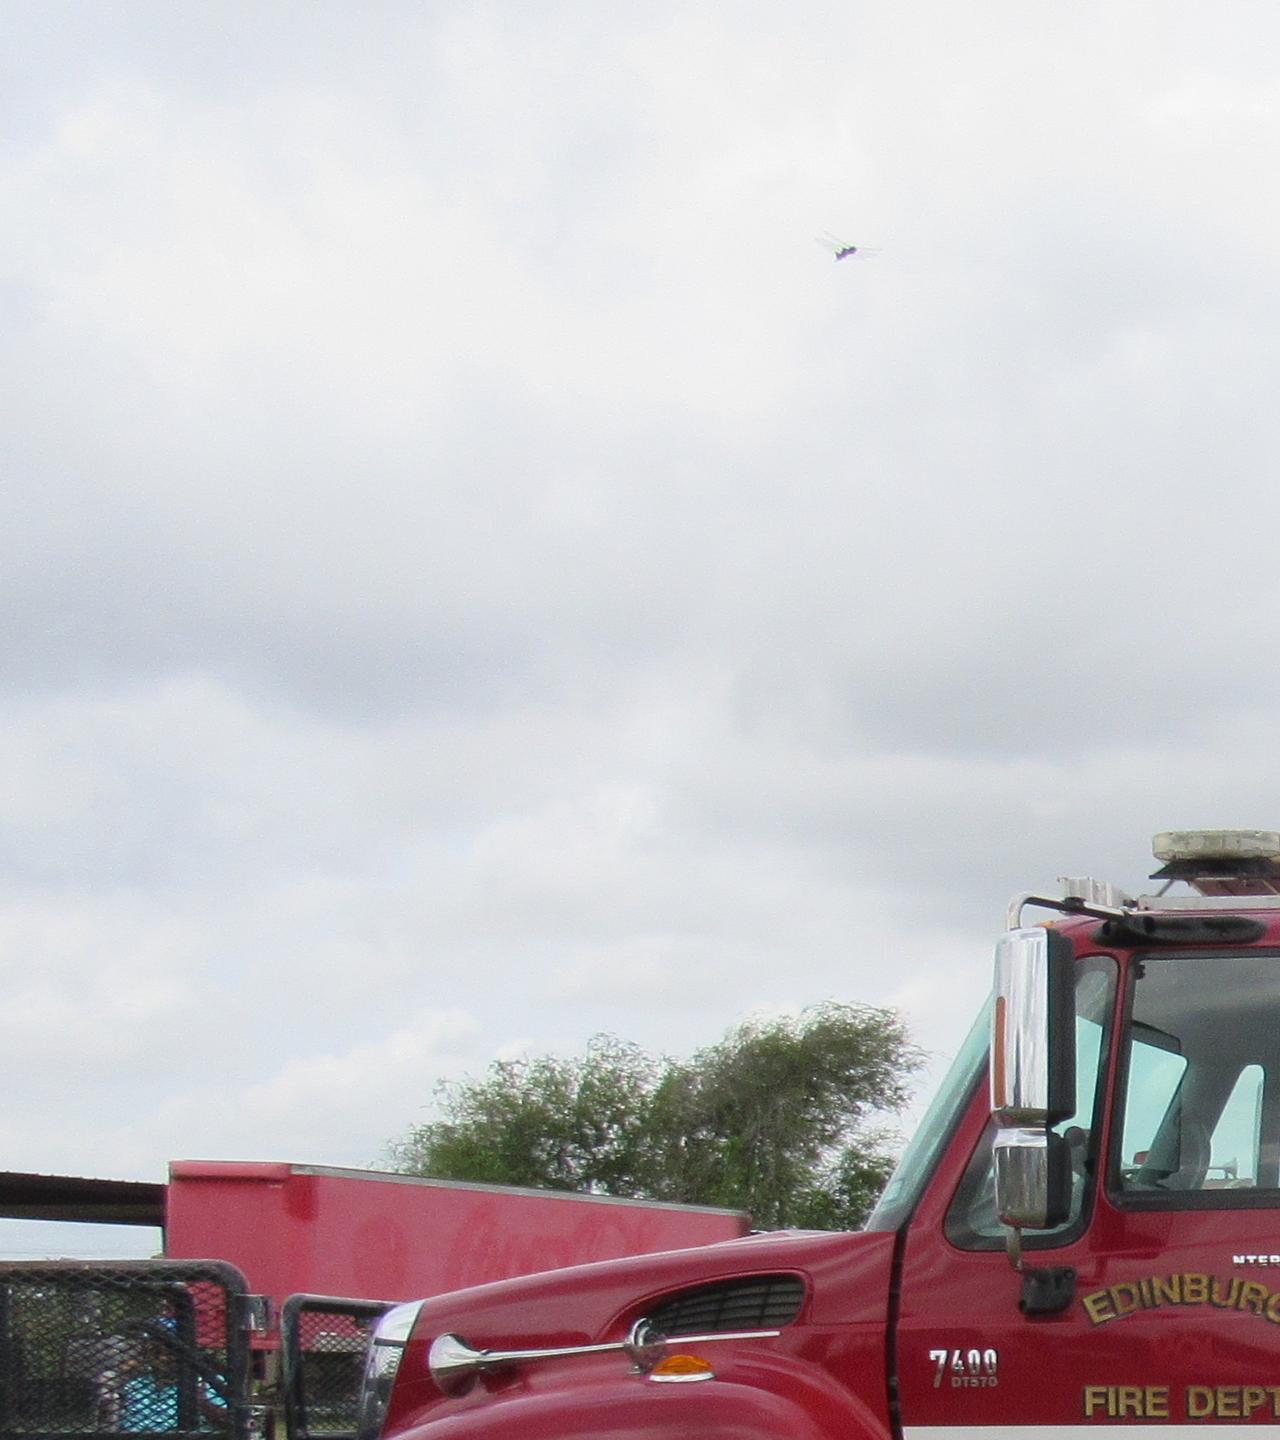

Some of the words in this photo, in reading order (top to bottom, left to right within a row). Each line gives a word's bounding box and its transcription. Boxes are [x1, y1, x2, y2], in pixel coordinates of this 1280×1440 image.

[928, 1348, 999, 1389] 7400
[951, 1376, 999, 1388] DT570
[1083, 1386, 1171, 1419] FIRE
